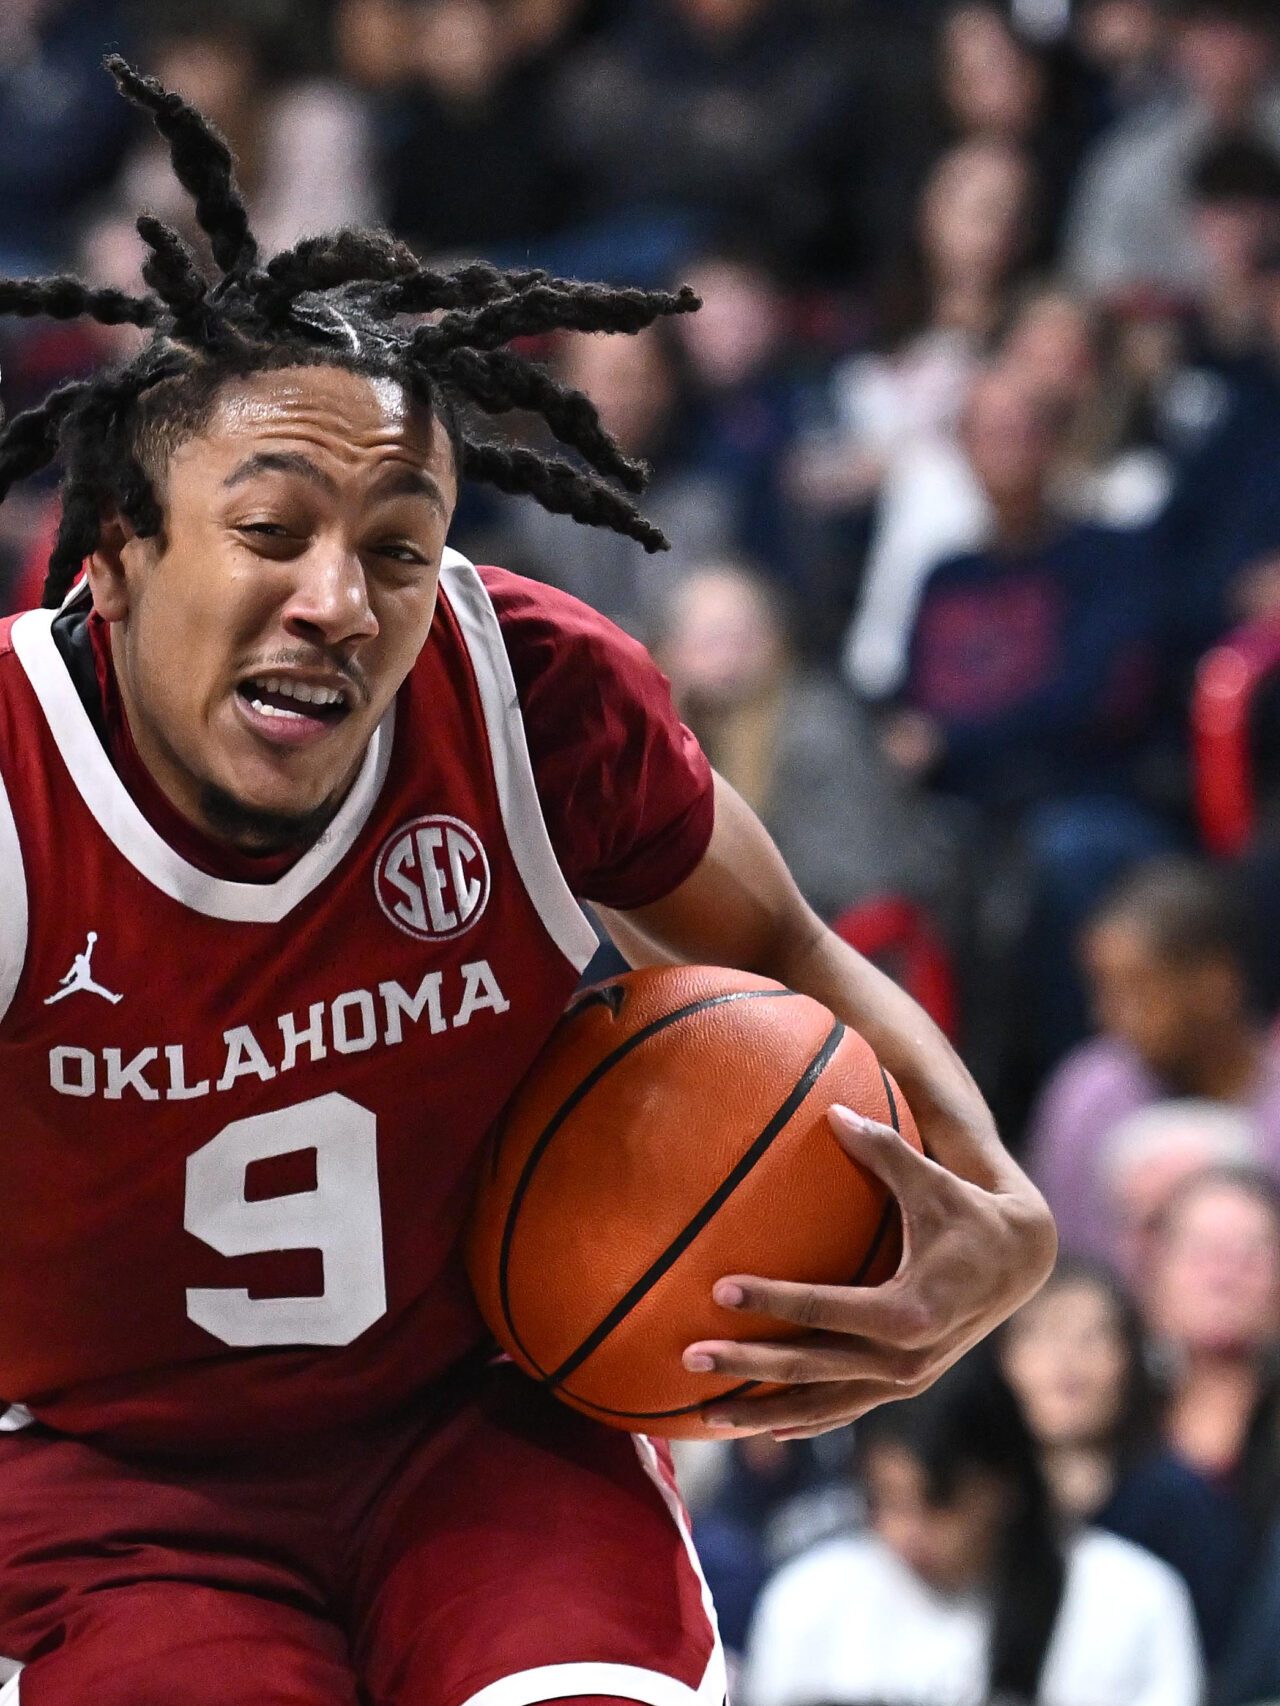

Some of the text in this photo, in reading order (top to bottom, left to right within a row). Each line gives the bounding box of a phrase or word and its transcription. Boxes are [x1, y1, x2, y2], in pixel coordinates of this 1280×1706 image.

[384, 827, 482, 934] SEC
[48, 960, 511, 1102] OKLAHOMA
[183, 1091, 387, 1347] 9
